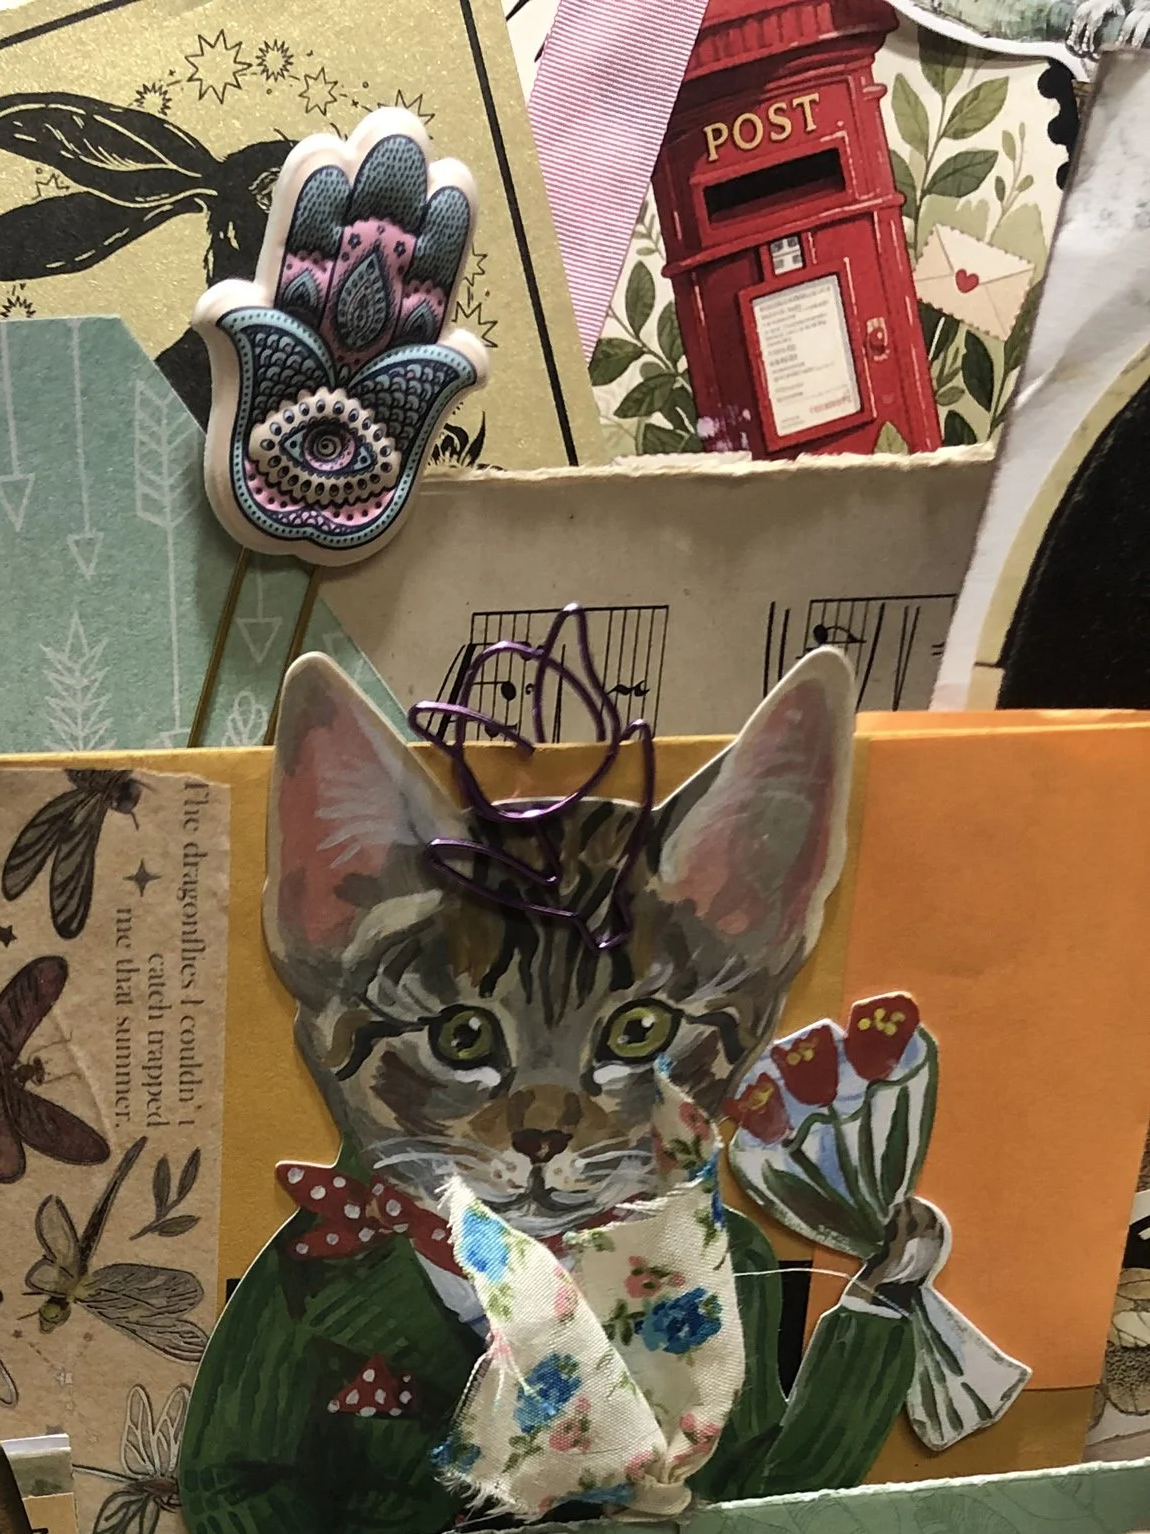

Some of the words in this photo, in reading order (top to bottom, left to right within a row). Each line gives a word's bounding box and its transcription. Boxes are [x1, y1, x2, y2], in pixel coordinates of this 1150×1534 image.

[703, 93, 819, 161] POST
[115, 908, 132, 949] me
[176, 842, 208, 990] dragonflies
[115, 959, 140, 1005] that
[148, 953, 172, 1021] catch
[115, 1016, 132, 1128] summer.
[141, 1031, 171, 1127] trapped
[179, 1015, 204, 1128] couldn't
